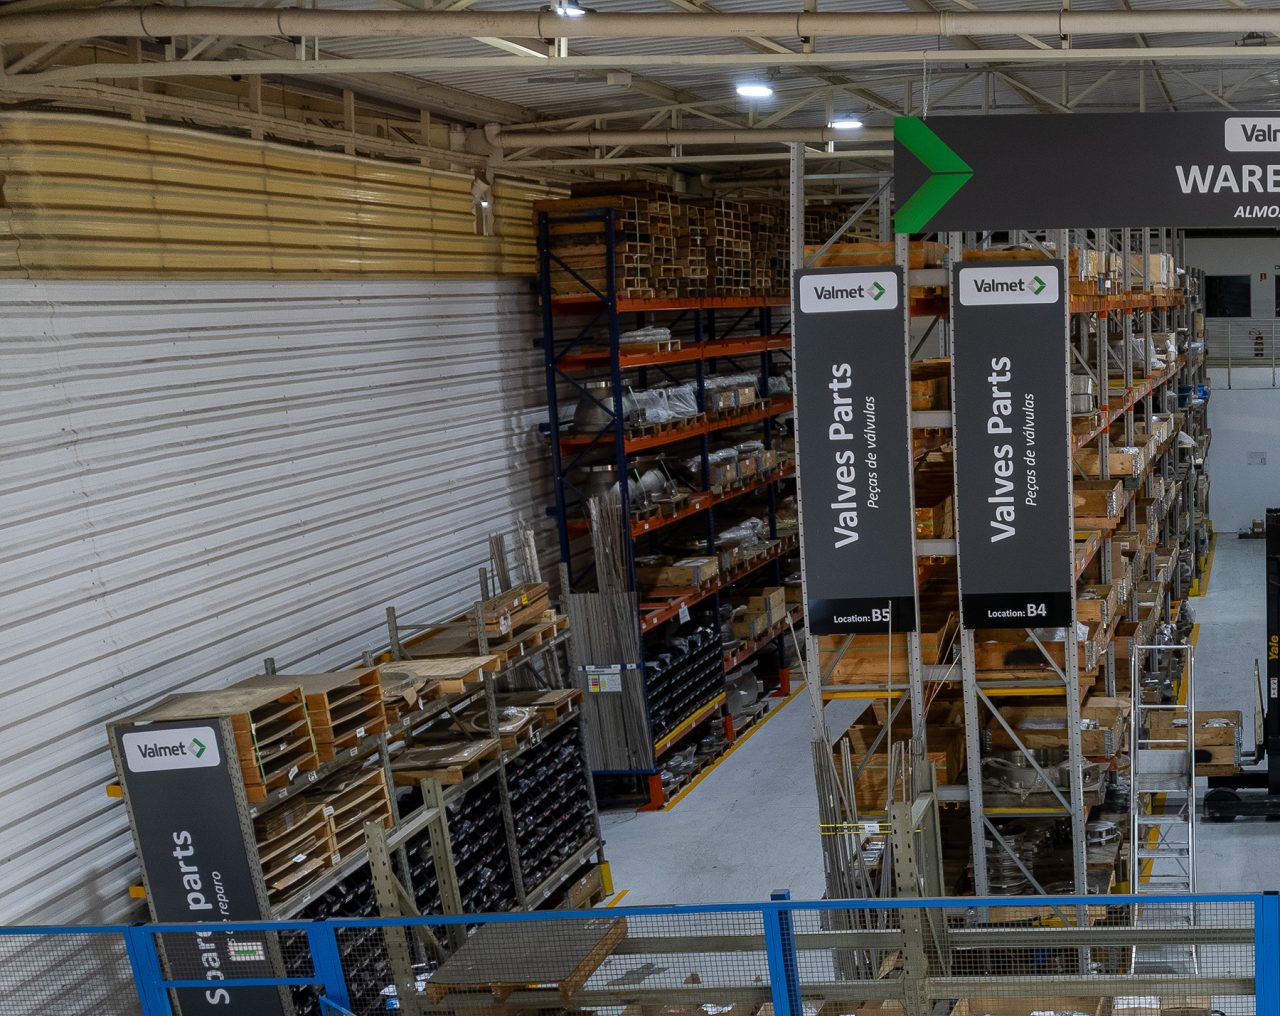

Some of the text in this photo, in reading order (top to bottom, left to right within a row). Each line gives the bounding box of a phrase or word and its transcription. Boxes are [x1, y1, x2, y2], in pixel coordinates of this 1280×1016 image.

[814, 285, 864, 300] Valmet
[974, 278, 1025, 293] Valmet
[829, 363, 859, 548] Valves Parts
[863, 395, 880, 509] Peças de válvulas
[988, 356, 1016, 543] Valves Parts
[1022, 393, 1037, 506] Peças de válvulas
[833, 608, 890, 625] Location: B5
[988, 603, 1047, 619] Location: B4
[1269, 635, 1279, 660] Yale
[137, 742, 187, 759] Valmet
[173, 831, 213, 910] parts
[211, 871, 230, 915] reparo
